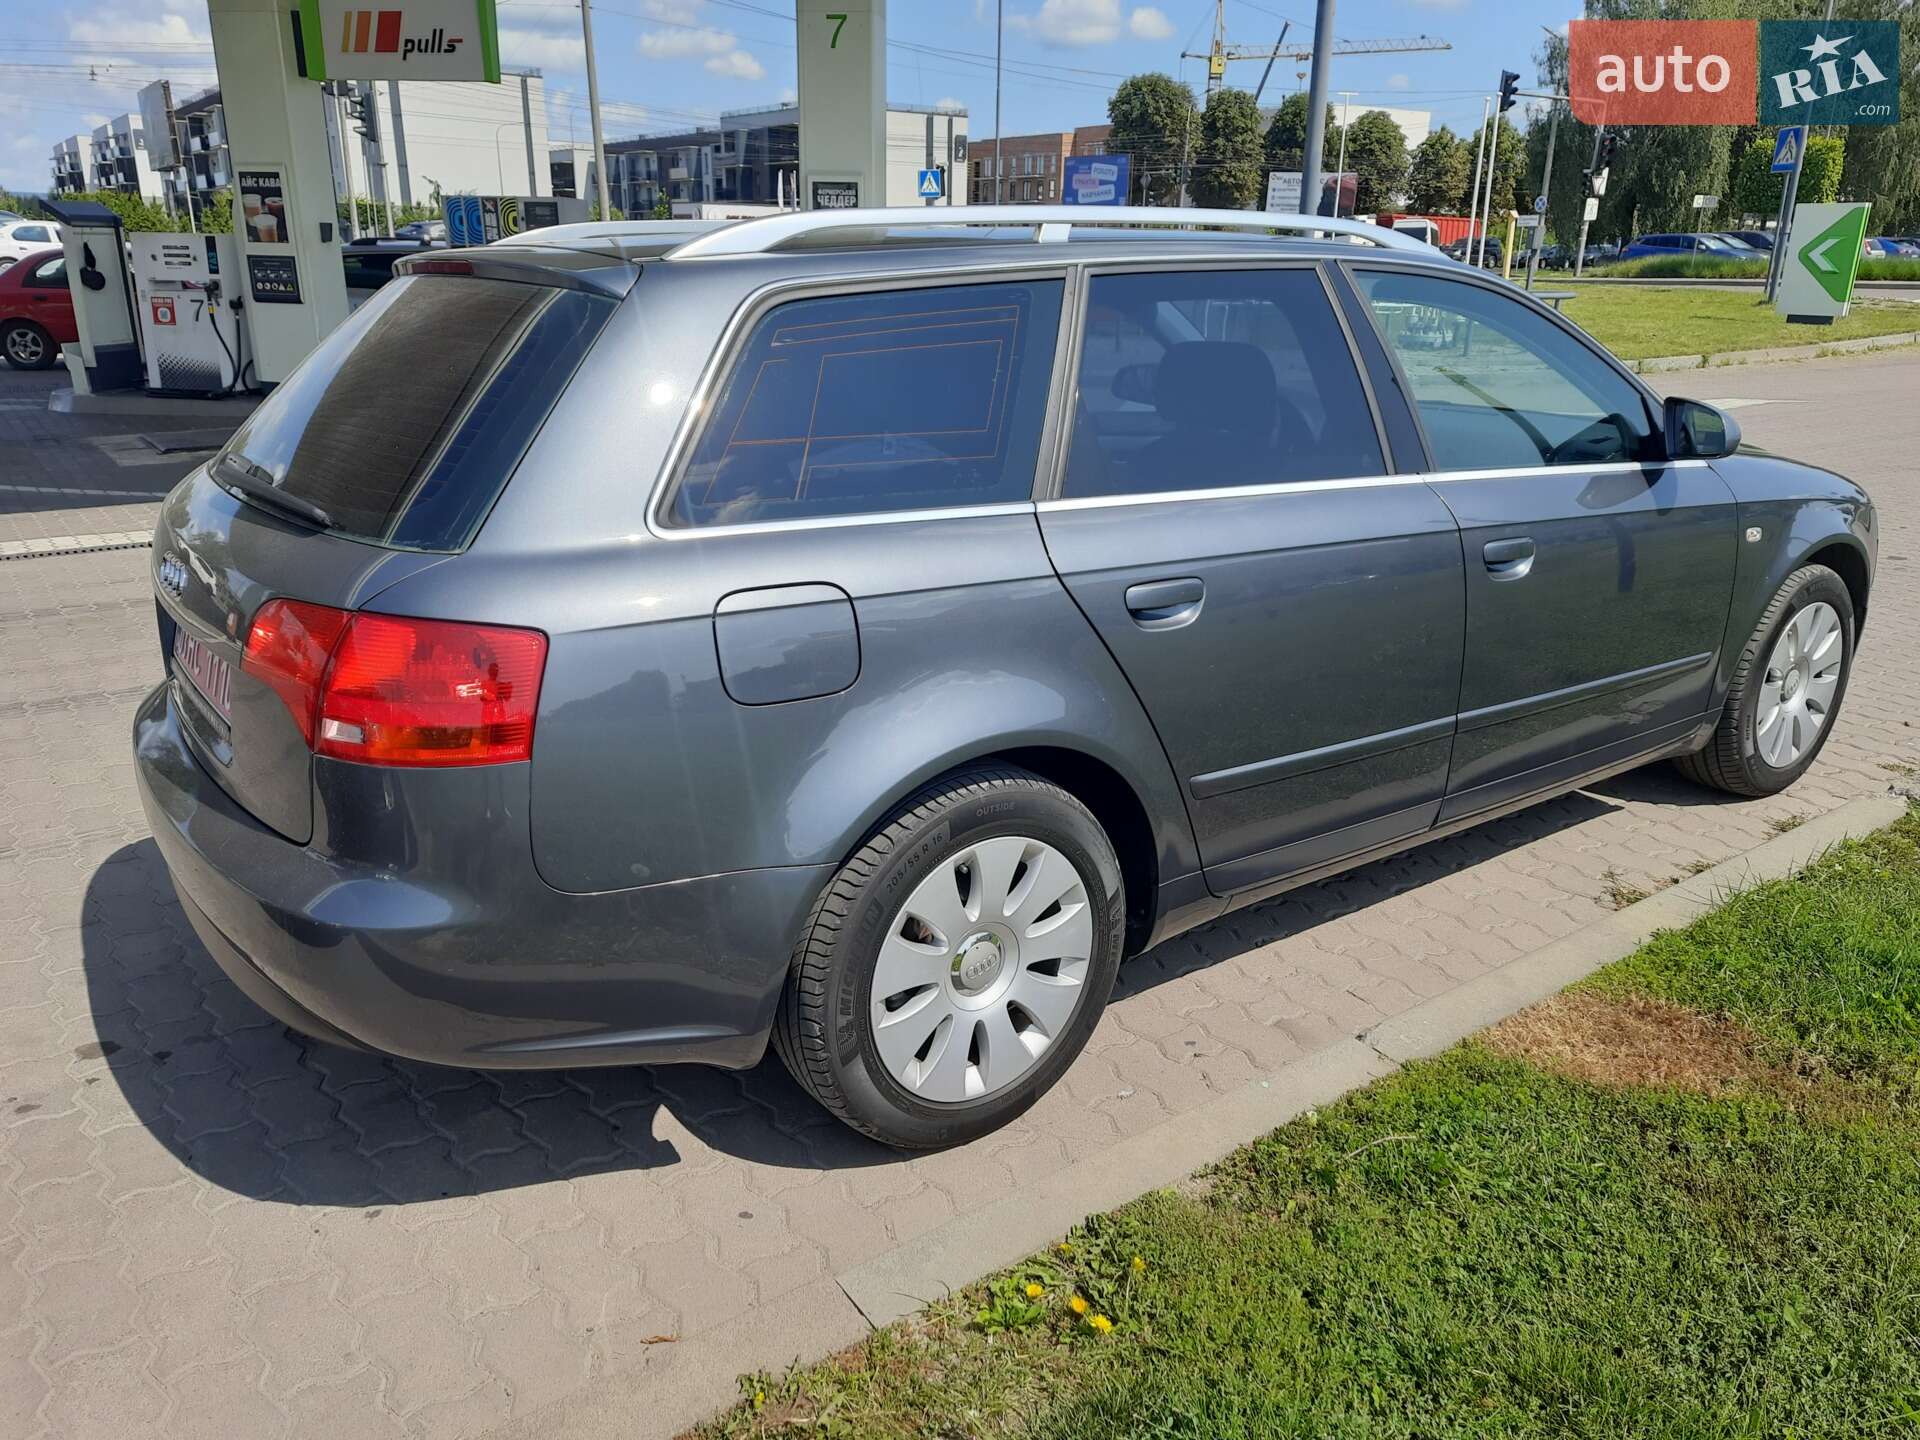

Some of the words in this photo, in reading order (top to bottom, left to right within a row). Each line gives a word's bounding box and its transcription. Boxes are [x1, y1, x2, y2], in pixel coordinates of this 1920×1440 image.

[826, 14, 847, 48] 7
[402, 28, 463, 61] pulls
[241, 175, 258, 188] АЙС
[258, 177, 281, 188] КАВА
[817, 195, 857, 208] ЧЕДДЕР
[190, 299, 204, 322] 7
[975, 801, 1016, 818] OUTSIDE
[886, 852, 920, 893] 205/55
[922, 843, 929, 855] R
[932, 832, 943, 846] 16
